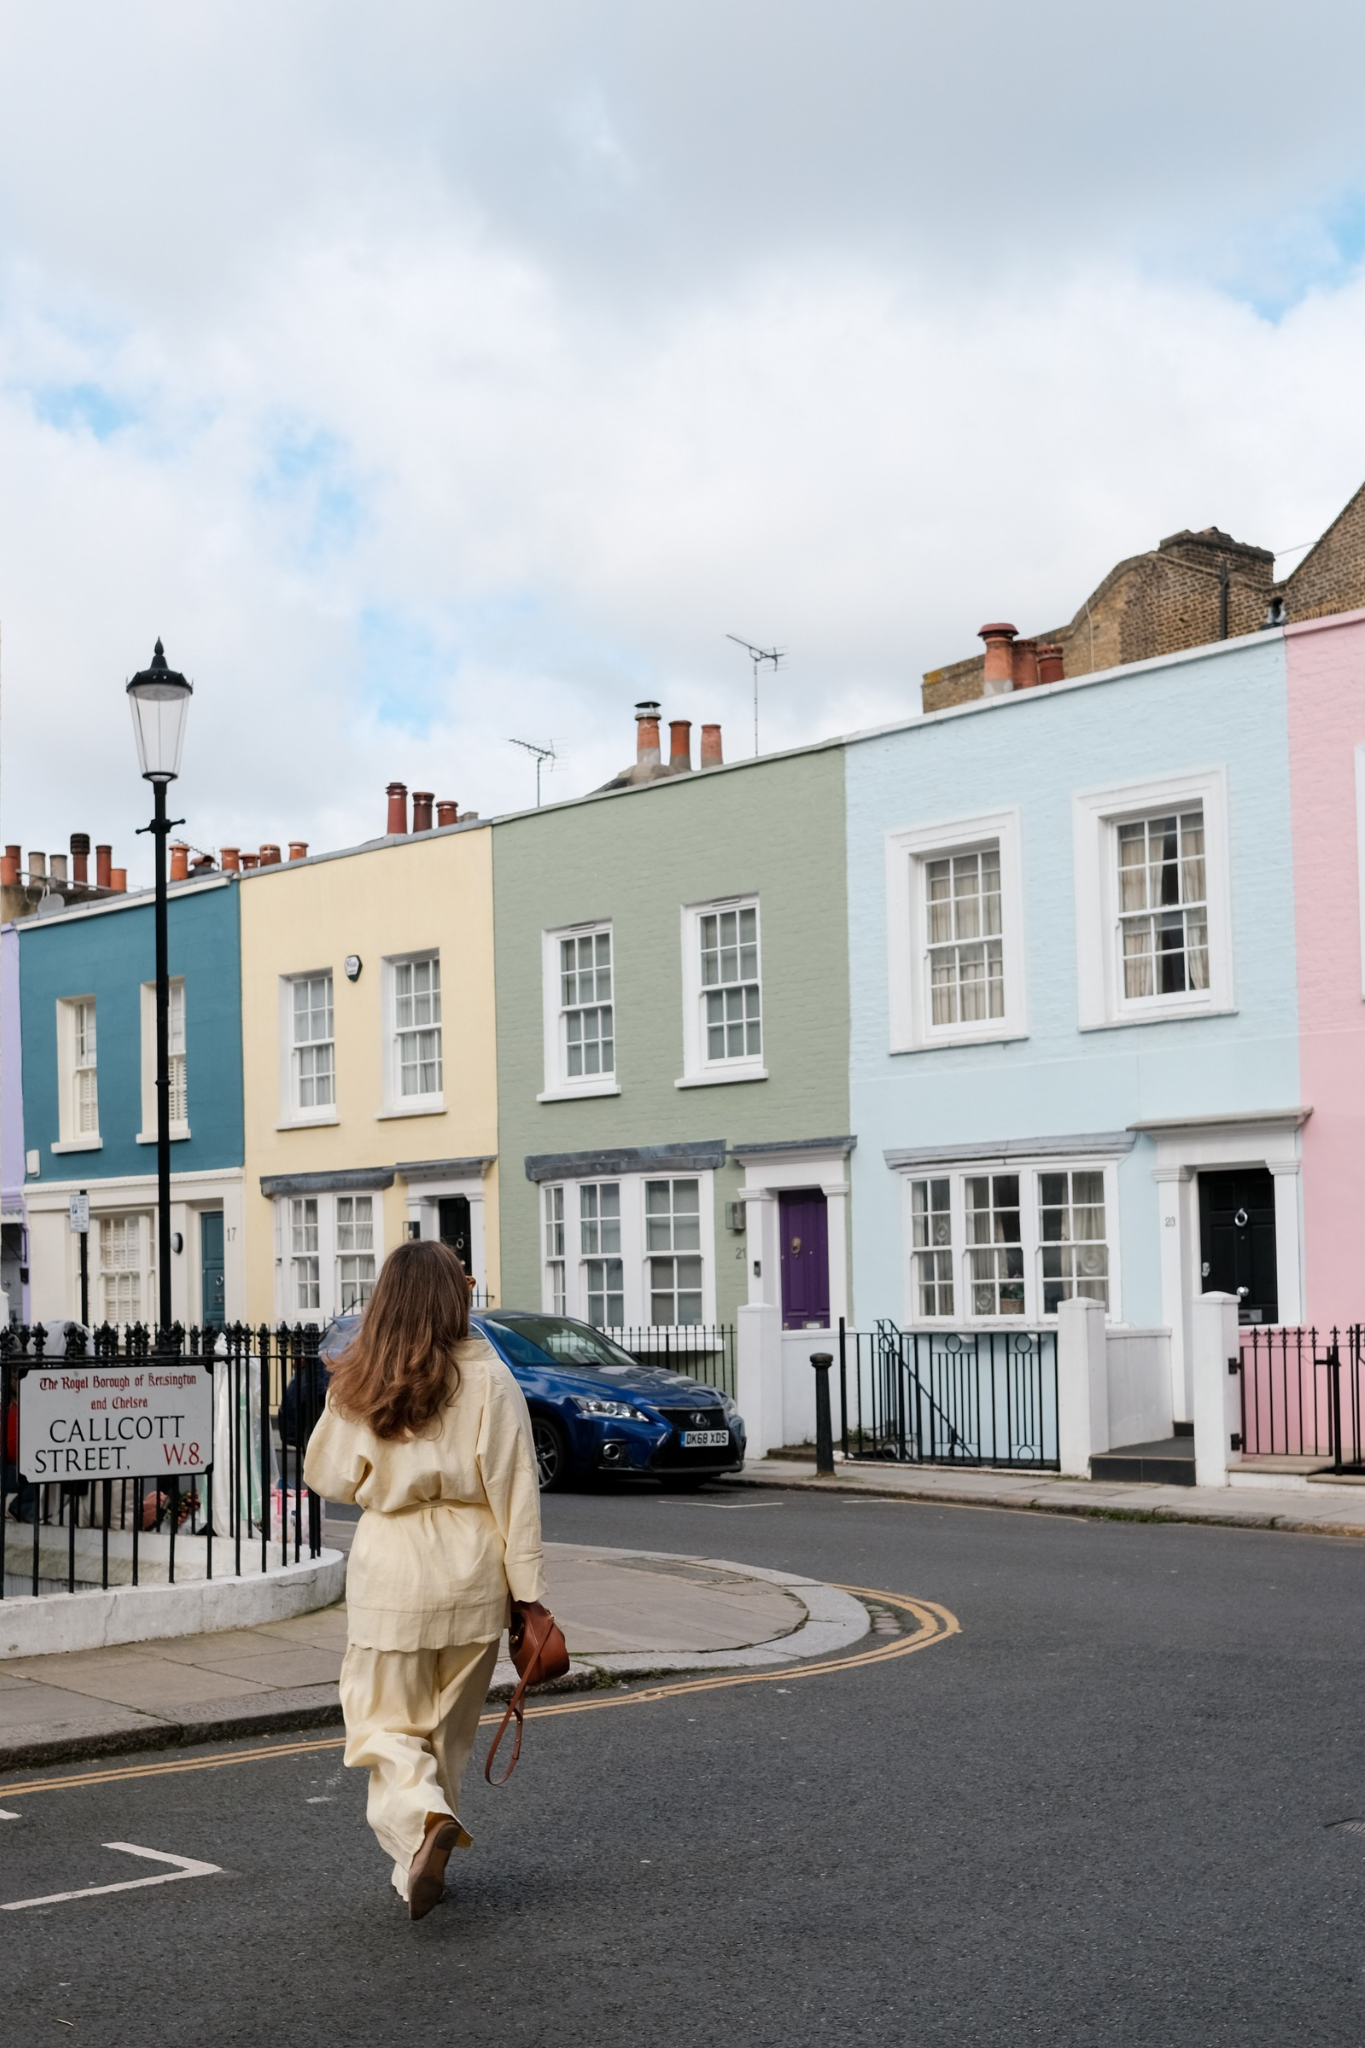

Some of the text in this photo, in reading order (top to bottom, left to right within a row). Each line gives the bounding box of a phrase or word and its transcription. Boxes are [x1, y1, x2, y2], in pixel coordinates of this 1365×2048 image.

[227, 1226, 237, 1241] 17
[735, 1246, 746, 1260] 21
[39, 1373, 197, 1393] The Royal Borough of Kensington
[90, 1396, 149, 1410] and Chelsea
[49, 1415, 185, 1443] CALLCOTT
[686, 1431, 727, 1445] DK68 XDS
